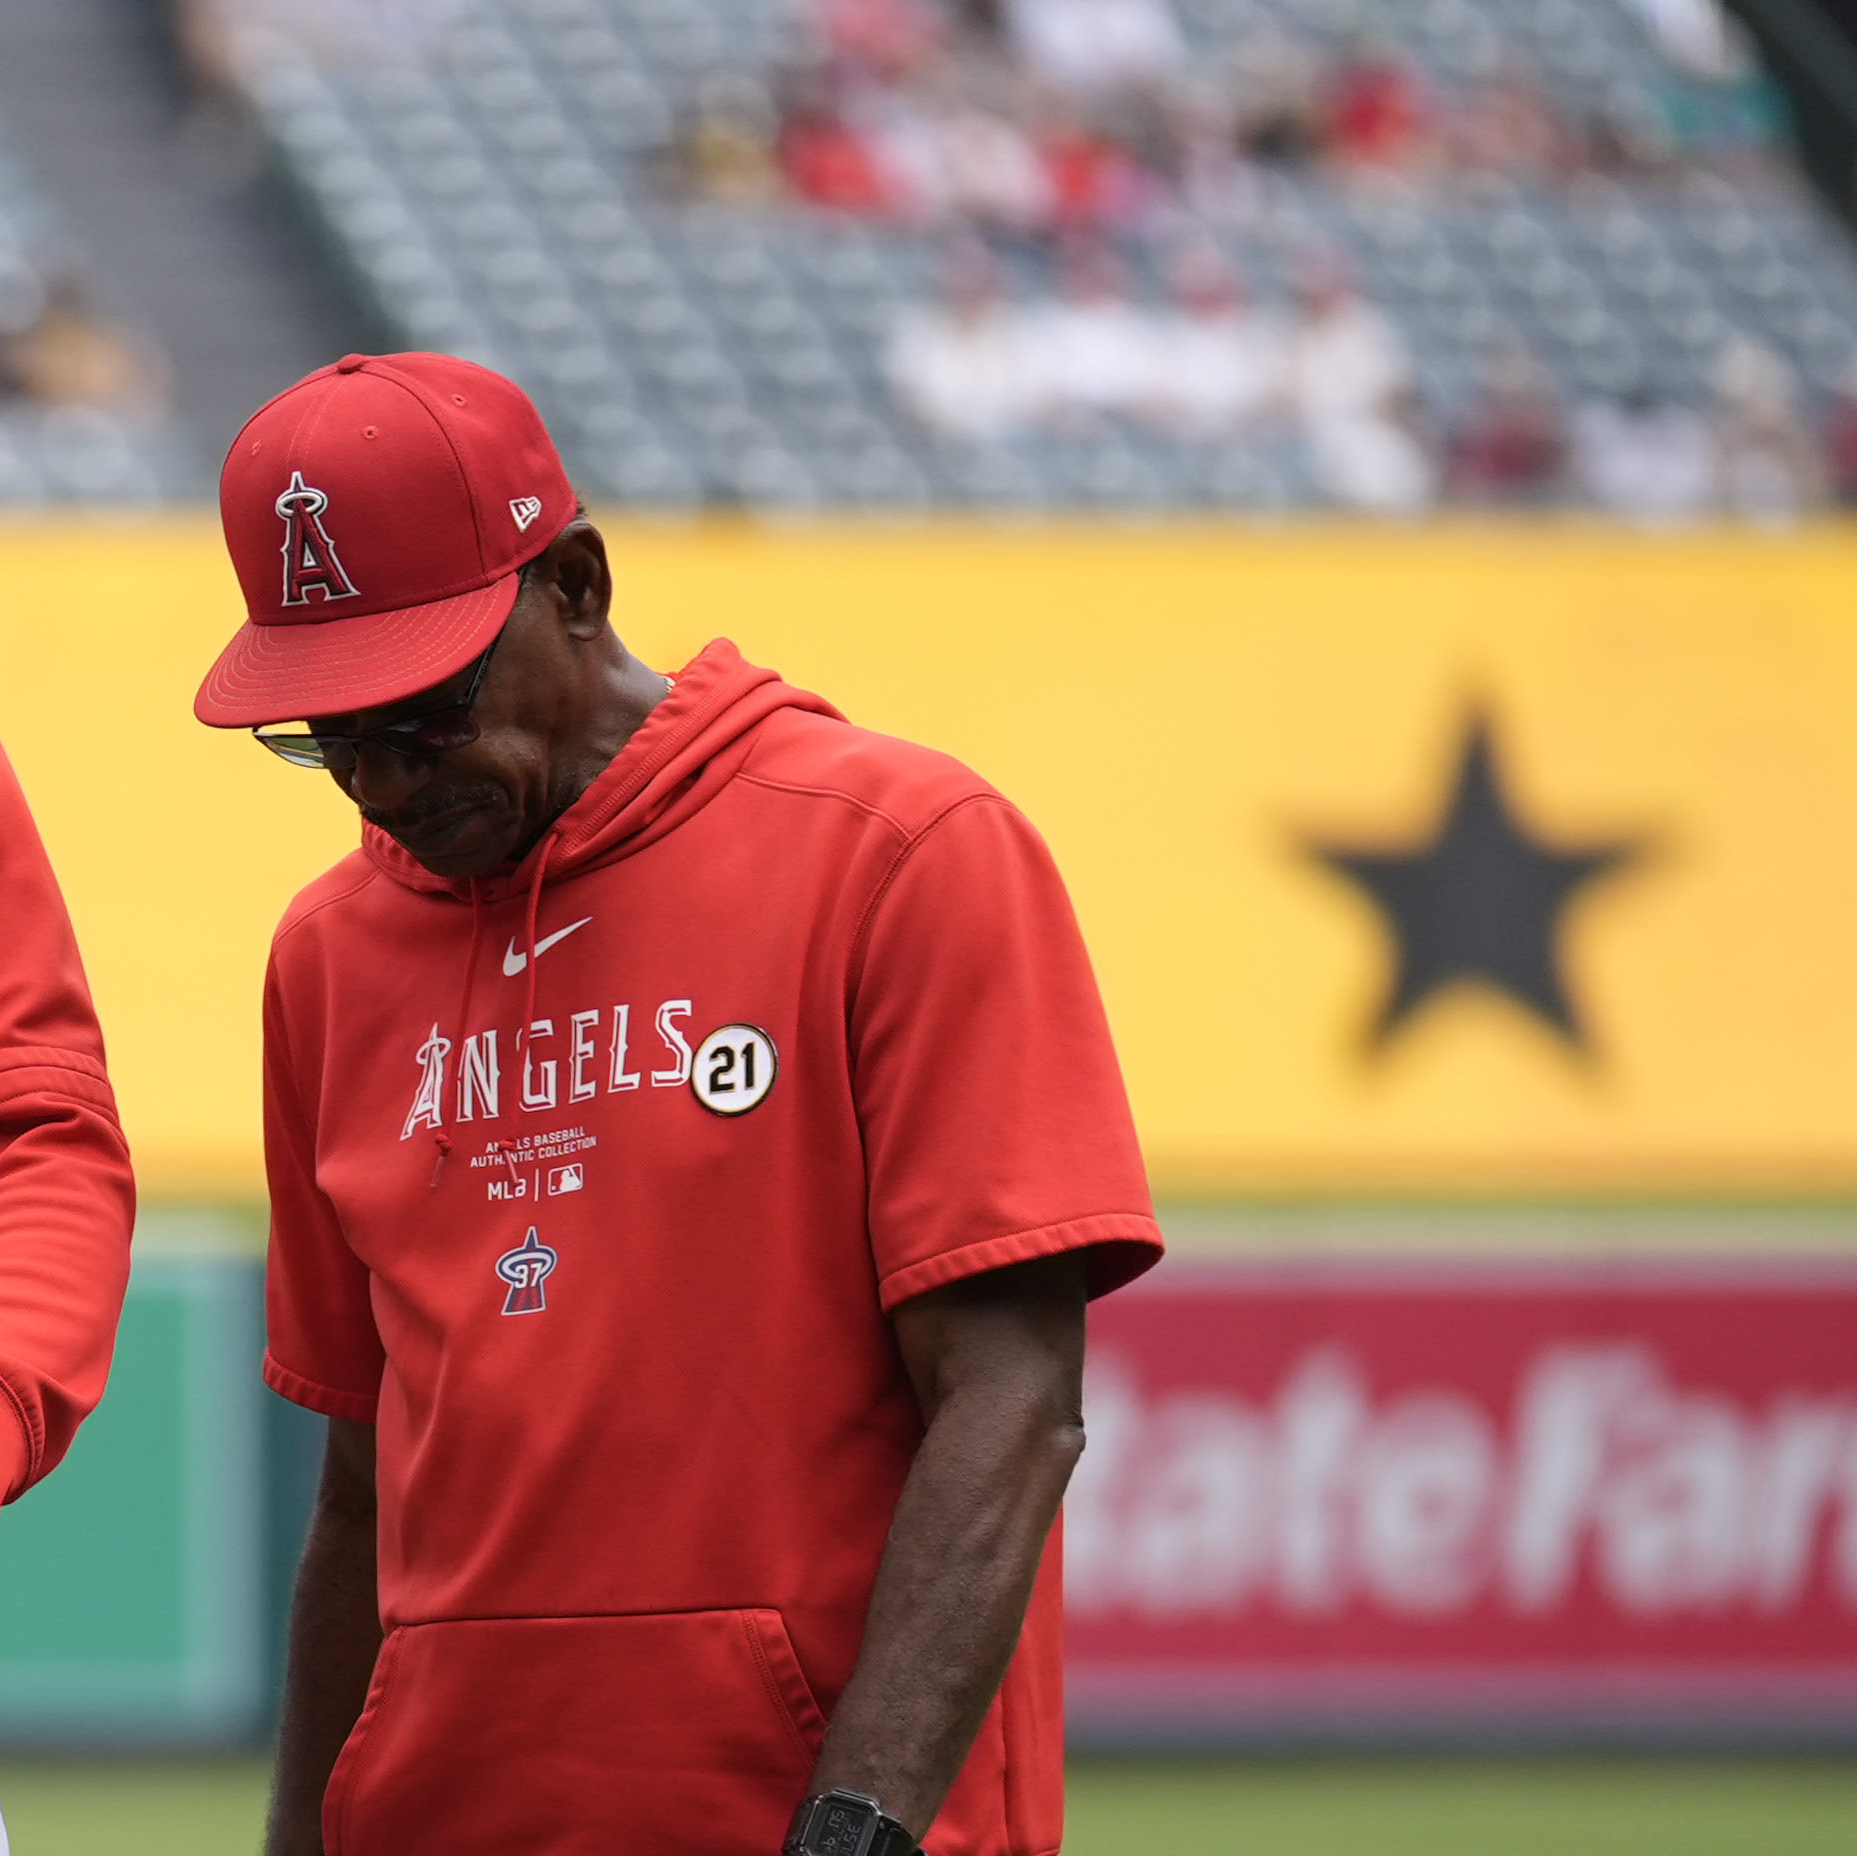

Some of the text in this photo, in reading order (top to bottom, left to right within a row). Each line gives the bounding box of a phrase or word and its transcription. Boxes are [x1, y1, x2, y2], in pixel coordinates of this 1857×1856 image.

[399, 999, 693, 1141] ANGELS
[709, 1042, 756, 1094] 21
[470, 1136, 597, 1169] AUTHNTIC COLLECTION
[486, 1126, 586, 1154] ALS BASEBALL
[488, 1178, 527, 1201] MLB
